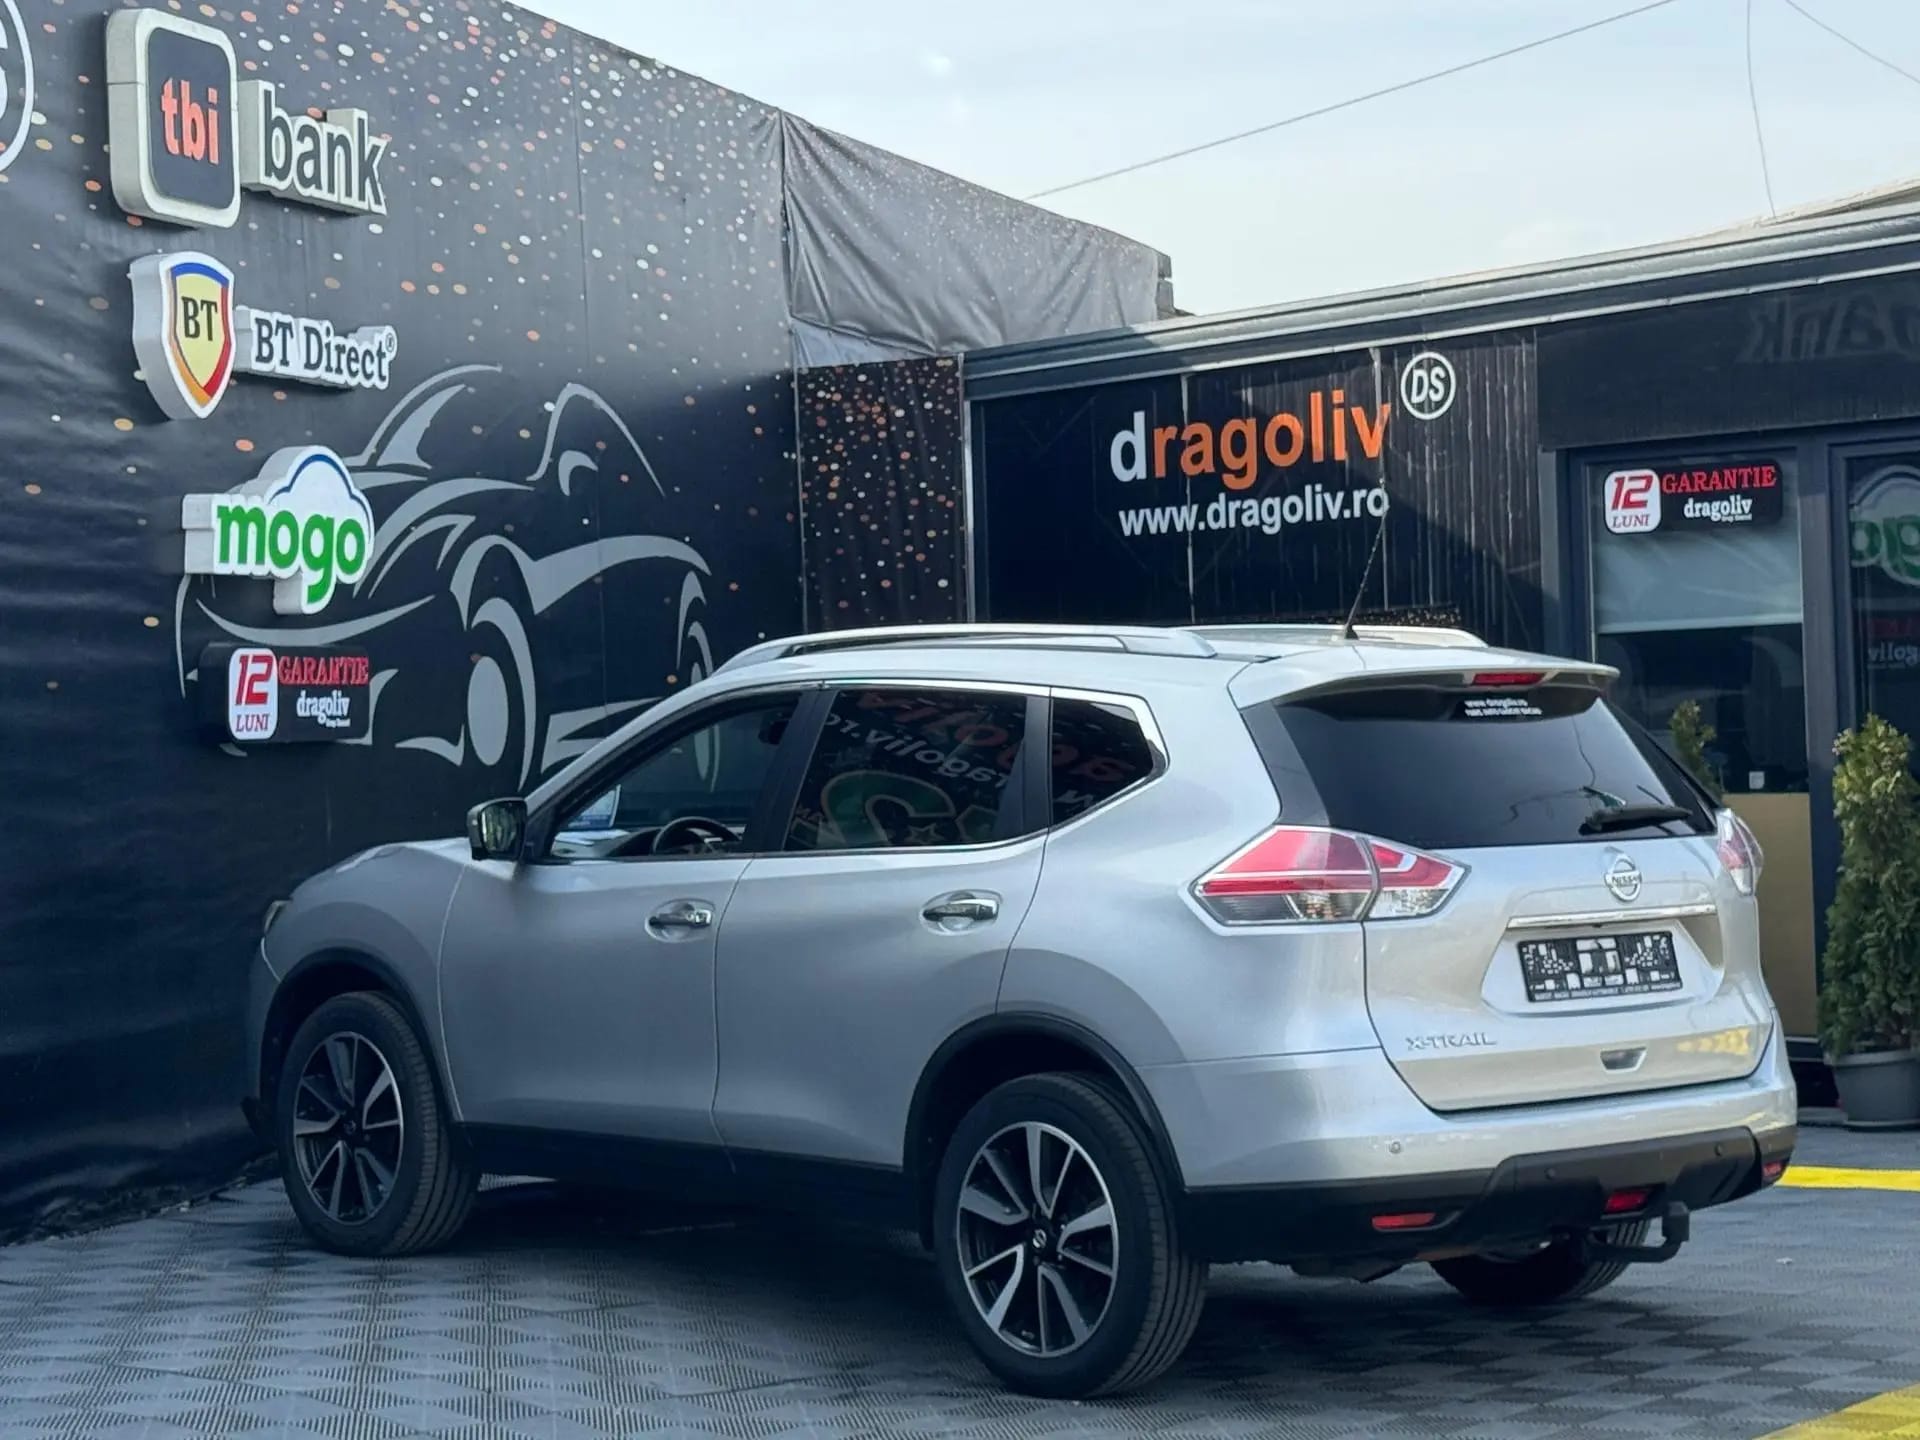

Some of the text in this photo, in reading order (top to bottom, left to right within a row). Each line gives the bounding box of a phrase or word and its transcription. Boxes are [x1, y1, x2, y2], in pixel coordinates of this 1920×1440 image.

[161, 78, 219, 165] tbi
[262, 89, 384, 209] bank
[181, 295, 218, 341] BT
[254, 317, 294, 368] BT
[1410, 367, 1446, 404] DS
[1109, 389, 1391, 490] dragoliv
[1611, 474, 1654, 511] 12
[1661, 465, 1777, 494] GARANTIE
[1118, 483, 1391, 537] www.dragoliv.ro
[1612, 513, 1650, 529] LUNI
[1683, 494, 1753, 522] dragoliv
[217, 504, 366, 605] mogo
[234, 654, 273, 706] 12
[279, 655, 370, 685] GARANTIE
[235, 713, 270, 733] LUNI
[297, 690, 350, 724] dragoliv
[1405, 1032, 1498, 1051] X-TRAIL
